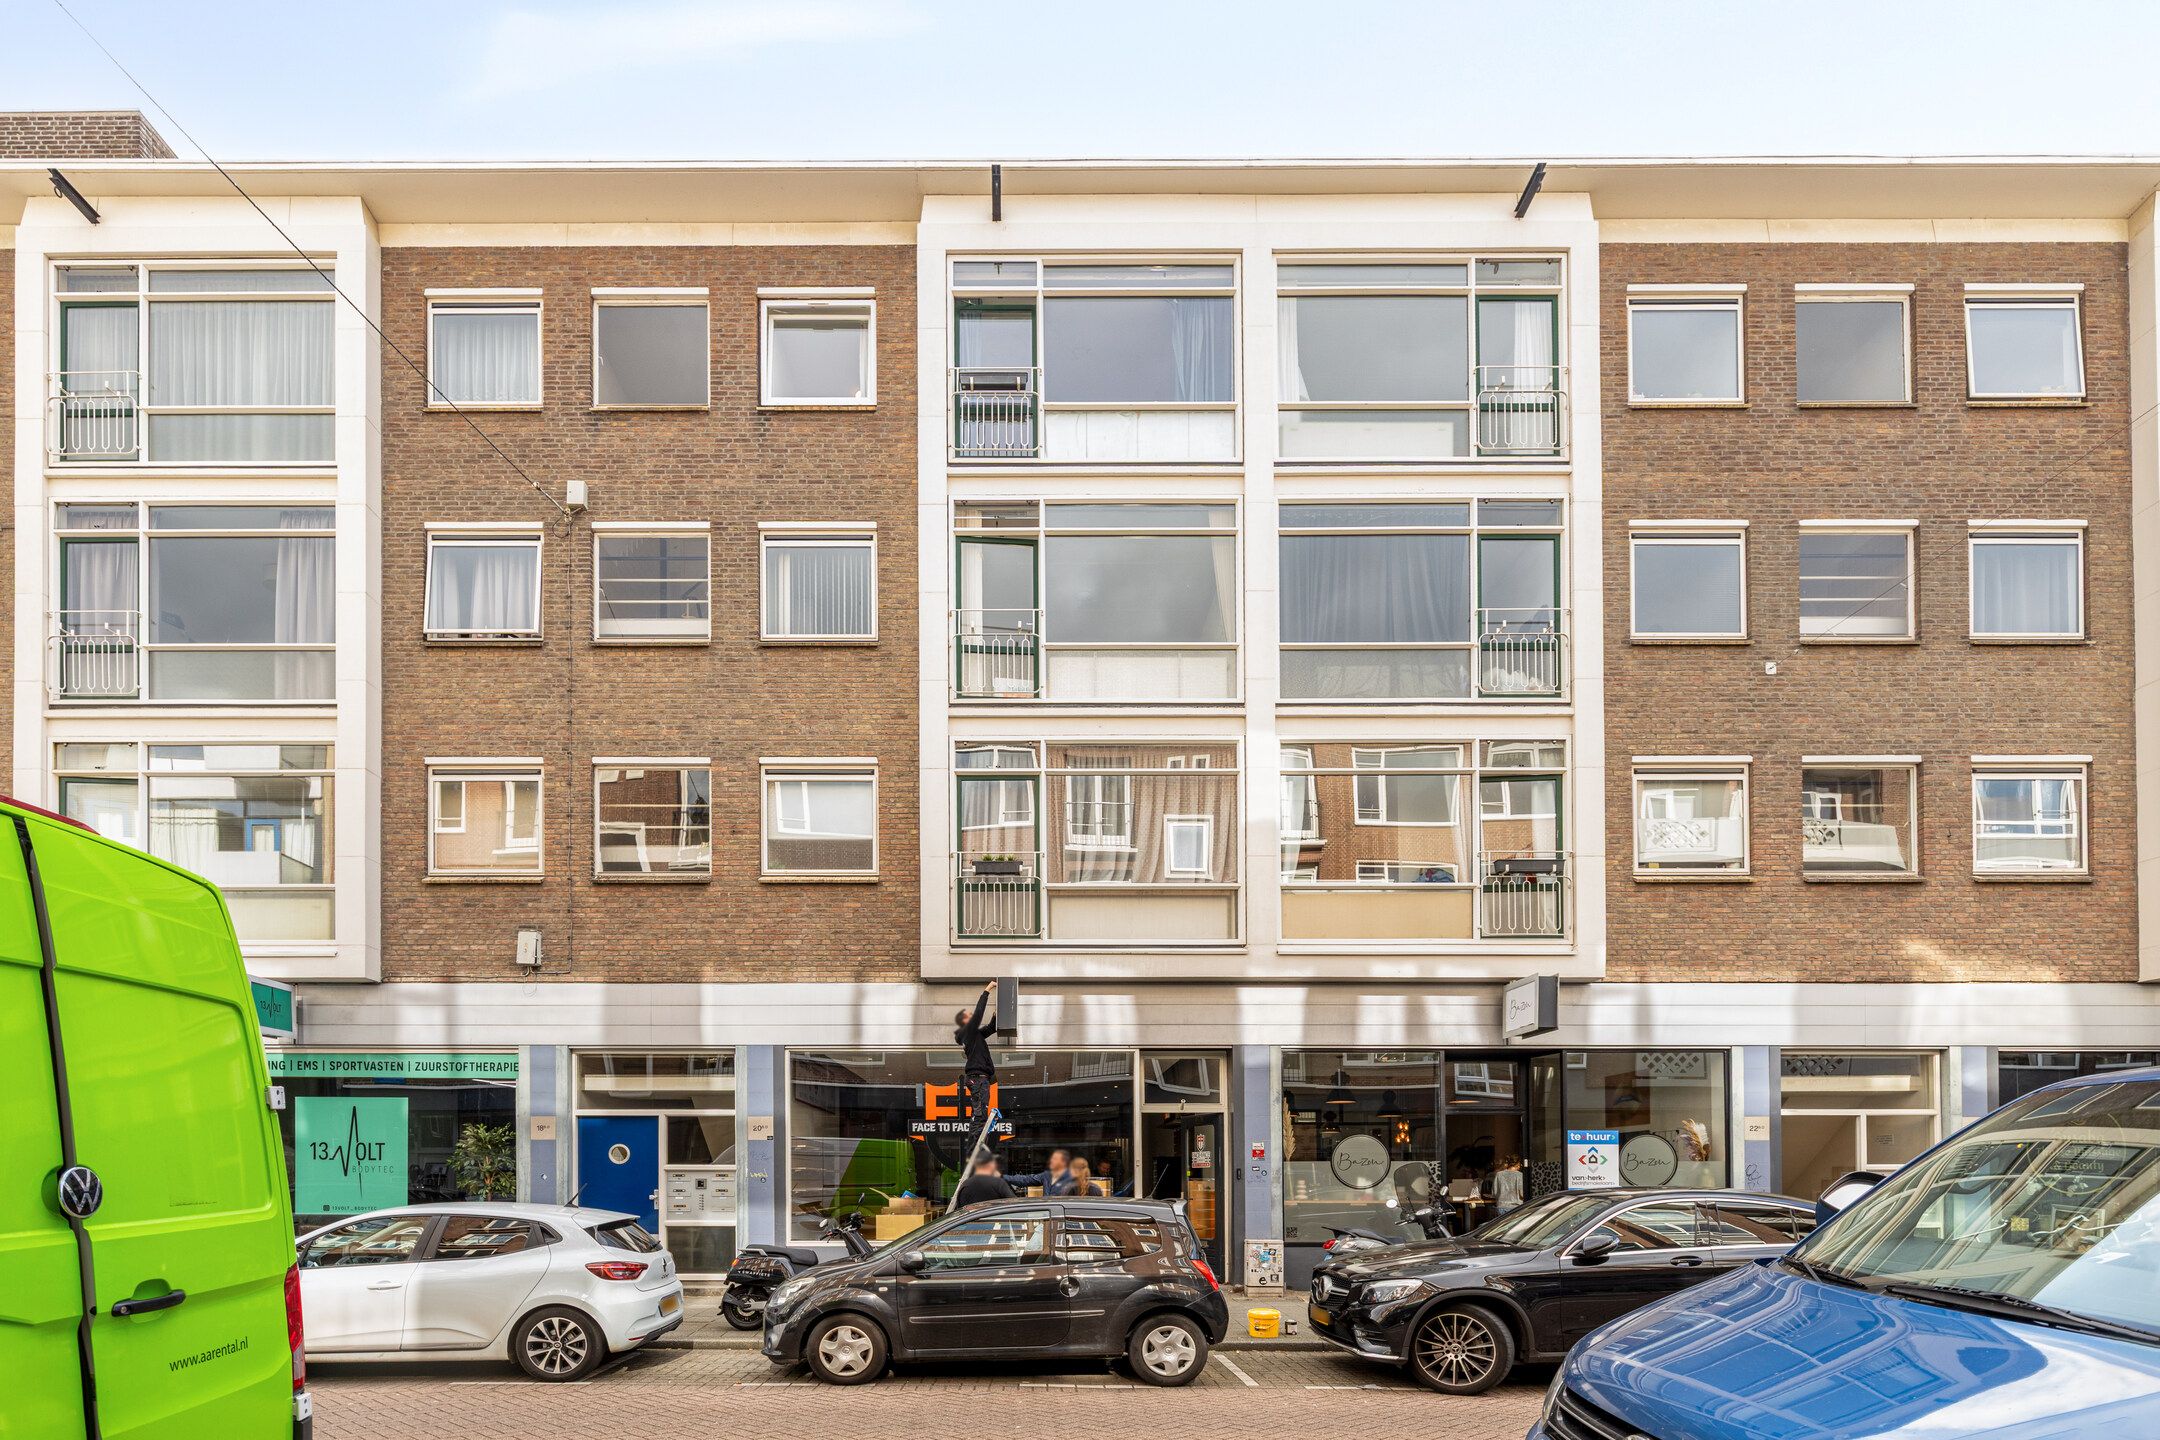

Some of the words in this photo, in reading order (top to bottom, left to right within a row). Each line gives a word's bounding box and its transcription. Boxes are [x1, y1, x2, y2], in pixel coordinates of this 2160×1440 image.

[297, 1060, 318, 1071] EMS
[329, 1060, 404, 1072] SPORTVASTEN
[415, 1061, 519, 1072] ZUURSTOFTHERAPIE
[912, 1122, 936, 1132] FACE
[938, 1122, 950, 1132] TO
[952, 1122, 970, 1132] FAC
[991, 1122, 1013, 1132] MES
[1570, 1132, 1581, 1141] te
[352, 1165, 395, 1174] BODYTEC
[168, 1335, 249, 1373] www.aarental.nl
